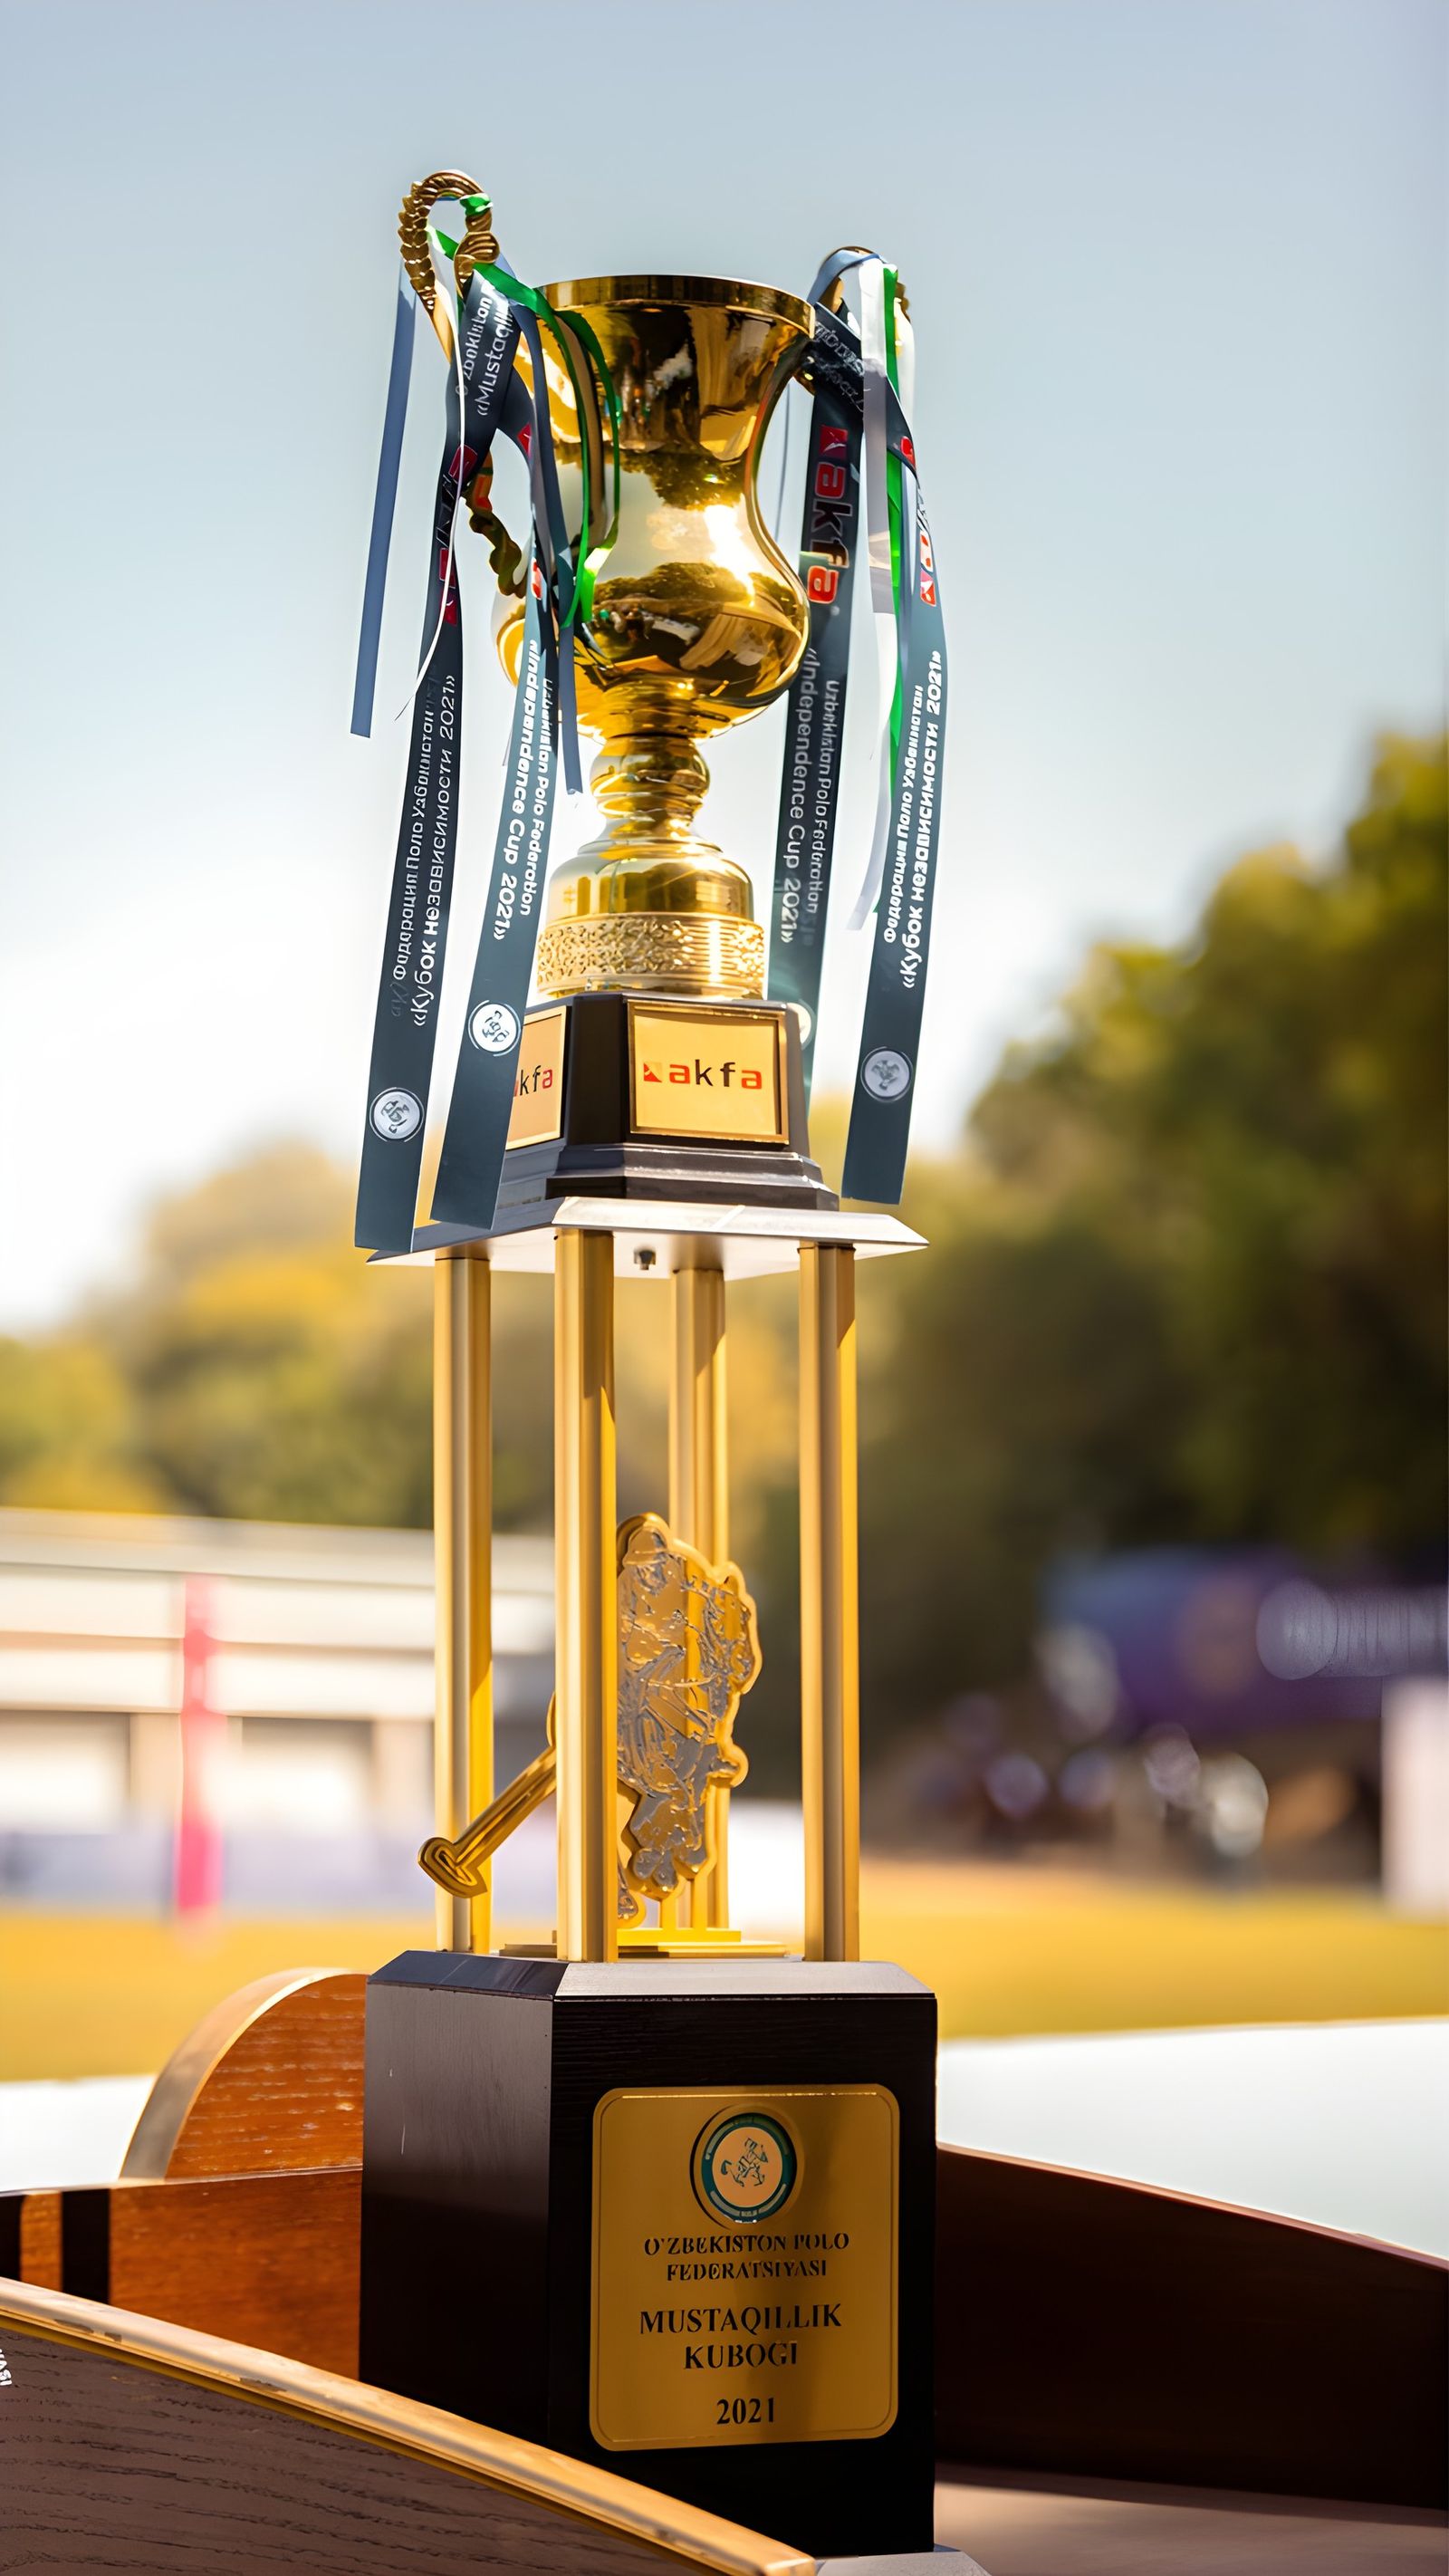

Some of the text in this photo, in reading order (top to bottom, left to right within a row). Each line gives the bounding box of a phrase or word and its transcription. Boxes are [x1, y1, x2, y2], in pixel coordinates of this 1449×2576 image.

[807, 462, 853, 604] akfa
[493, 639, 541, 940] «Independence Cup 2021»
[533, 775, 550, 816] Polo
[816, 777, 831, 816] Polo
[897, 791, 914, 839] Поло
[899, 650, 942, 989] «Кубок независимости 2021»
[406, 822, 424, 870] Поло
[410, 675, 456, 1026] «Кубок независимости 2021»
[520, 818, 545, 916] Federation
[783, 824, 806, 869] Cup
[807, 819, 828, 914] Federation
[781, 877, 801, 944] 2021»
[513, 1065, 552, 1097] kfa
[669, 1059, 763, 1090] akfa
[794, 2233, 849, 2251] POLO
[667, 2260, 826, 2281] FEDERATSIYASI
[640, 2303, 841, 2335] MUSTAQILLIK
[684, 2341, 798, 2369] KUBOGI
[716, 2398, 774, 2425] 2021
